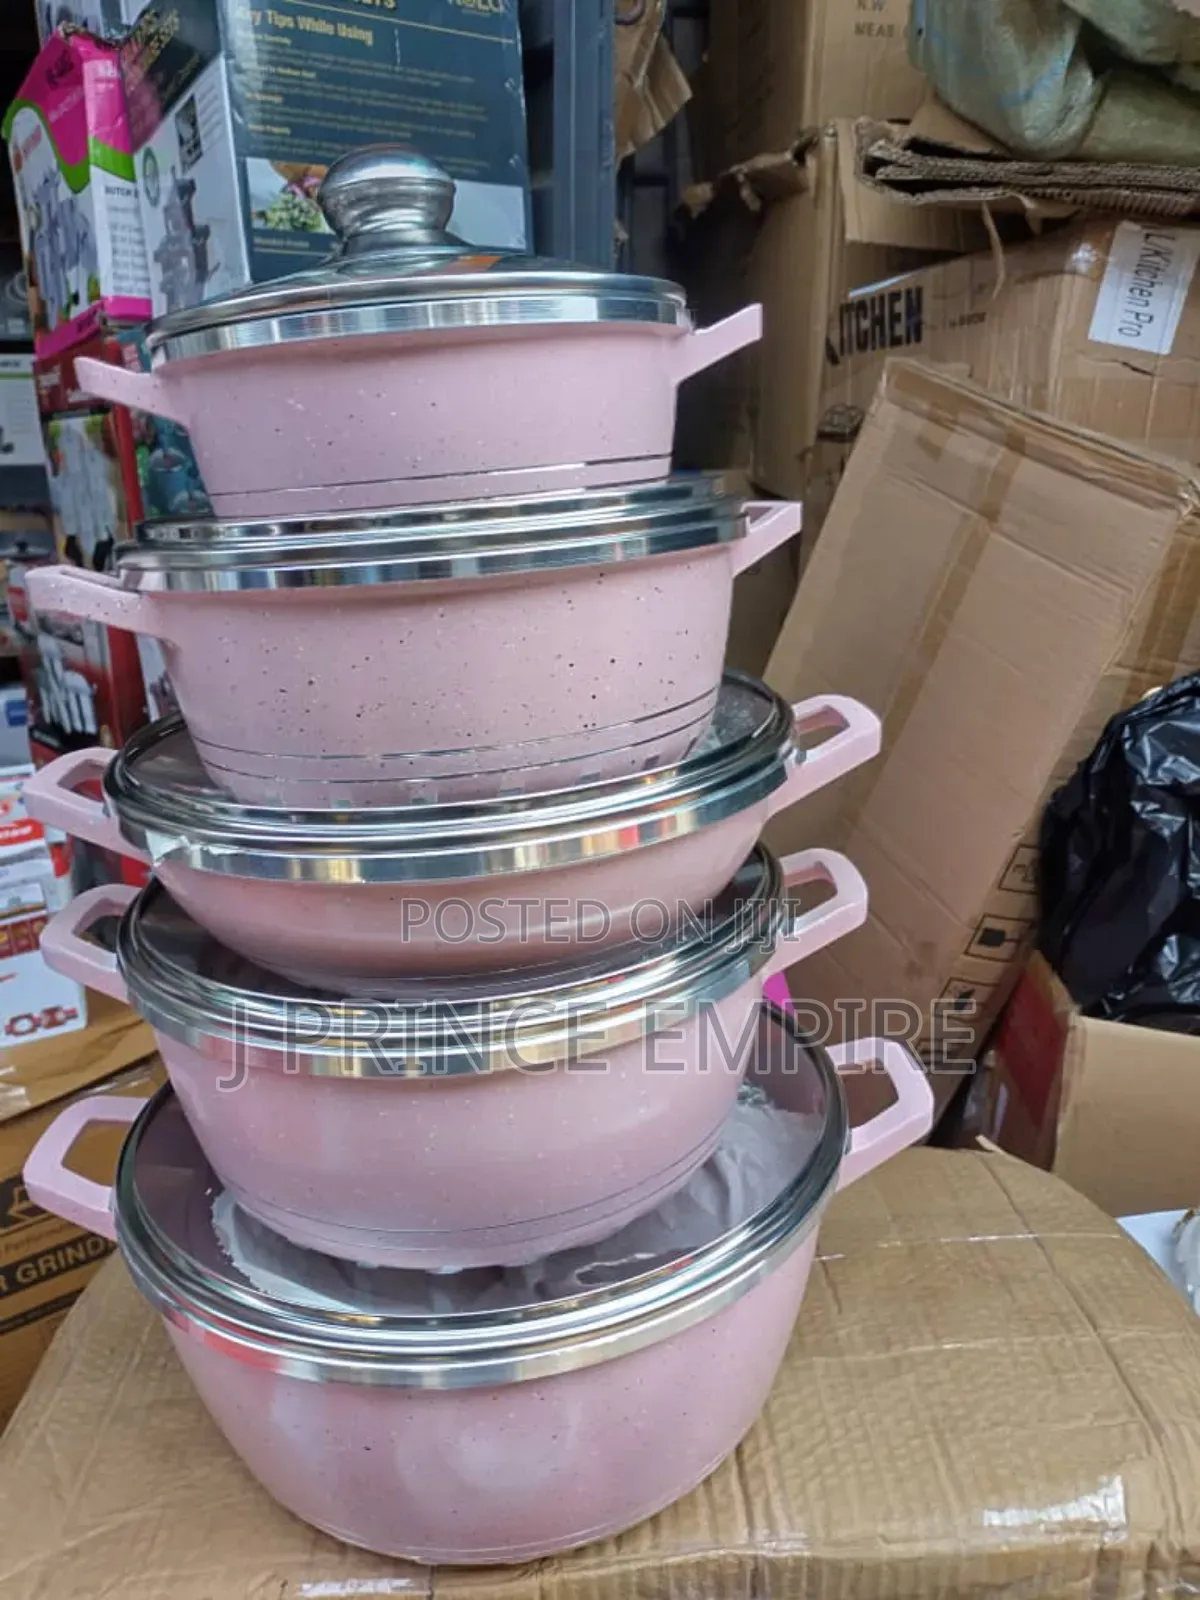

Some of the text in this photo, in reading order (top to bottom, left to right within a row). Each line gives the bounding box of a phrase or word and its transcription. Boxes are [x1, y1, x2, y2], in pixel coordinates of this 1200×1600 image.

[267, 9, 295, 29] Tips
[297, 15, 334, 36] While
[337, 22, 373, 47] Using
[16, 1236, 117, 1285] GRIND
